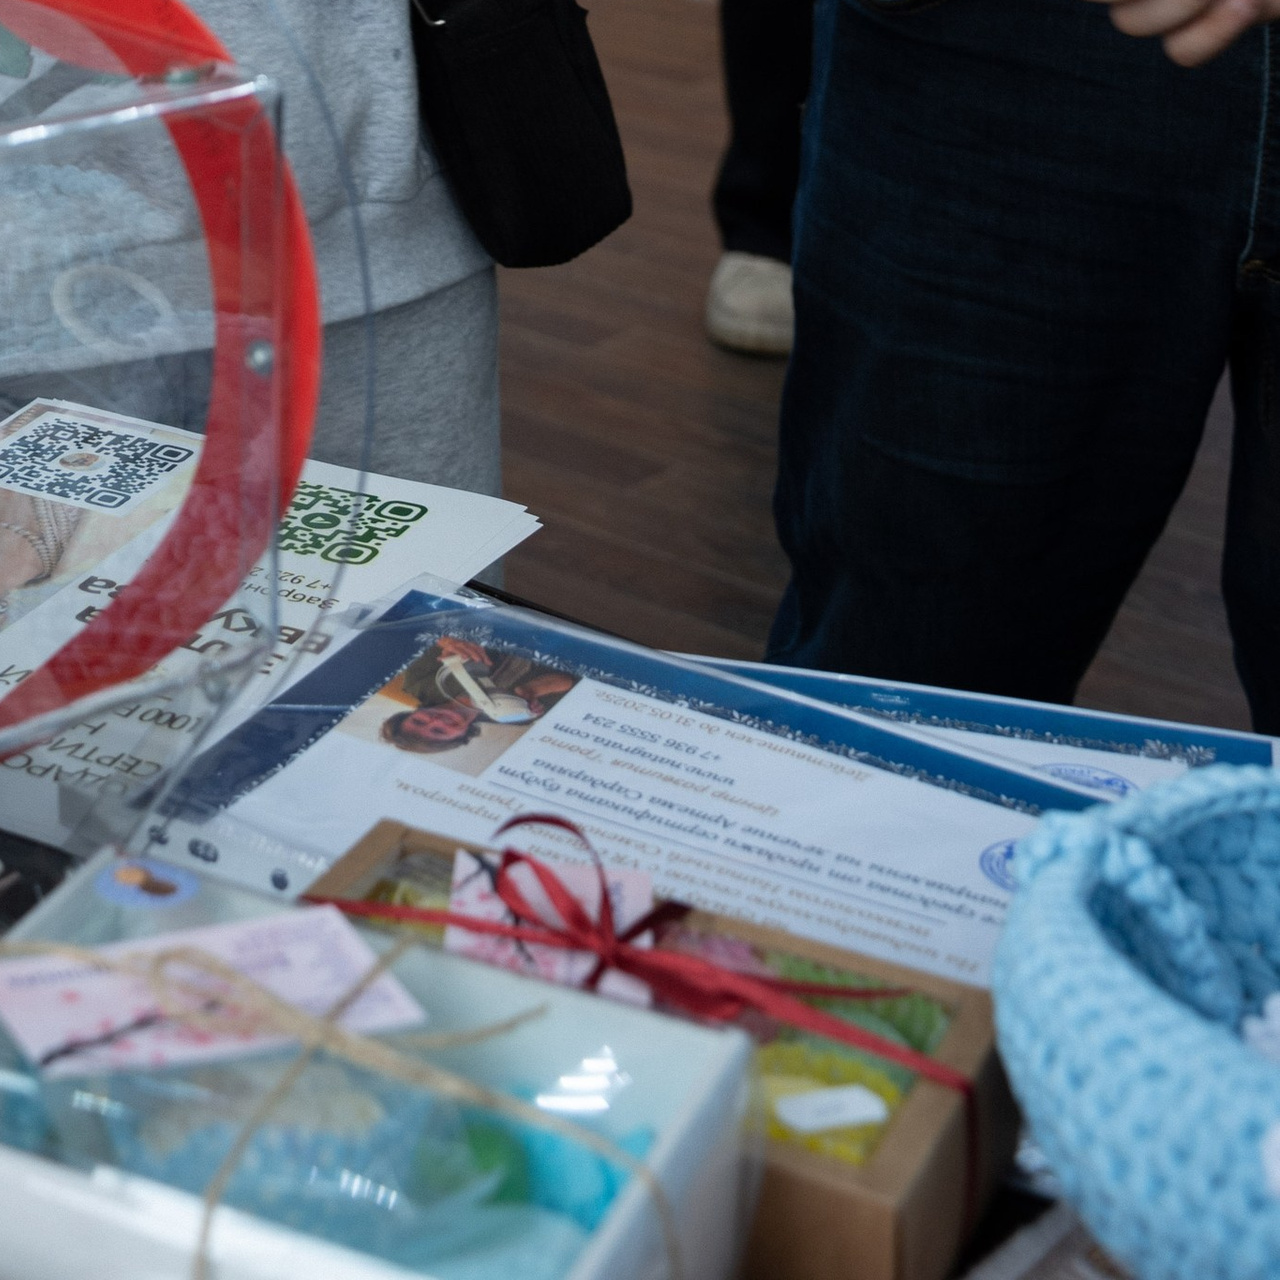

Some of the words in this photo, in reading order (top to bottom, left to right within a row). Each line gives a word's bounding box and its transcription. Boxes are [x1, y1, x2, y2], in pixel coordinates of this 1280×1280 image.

[579, 711, 618, 729] 234
[614, 722, 663, 743] 5555
[660, 736, 701, 755] 936
[491, 762, 566, 793] будут
[526, 755, 648, 801] Сардаряна
[559, 784, 723, 843] сертификата
[644, 793, 740, 829] Артема
